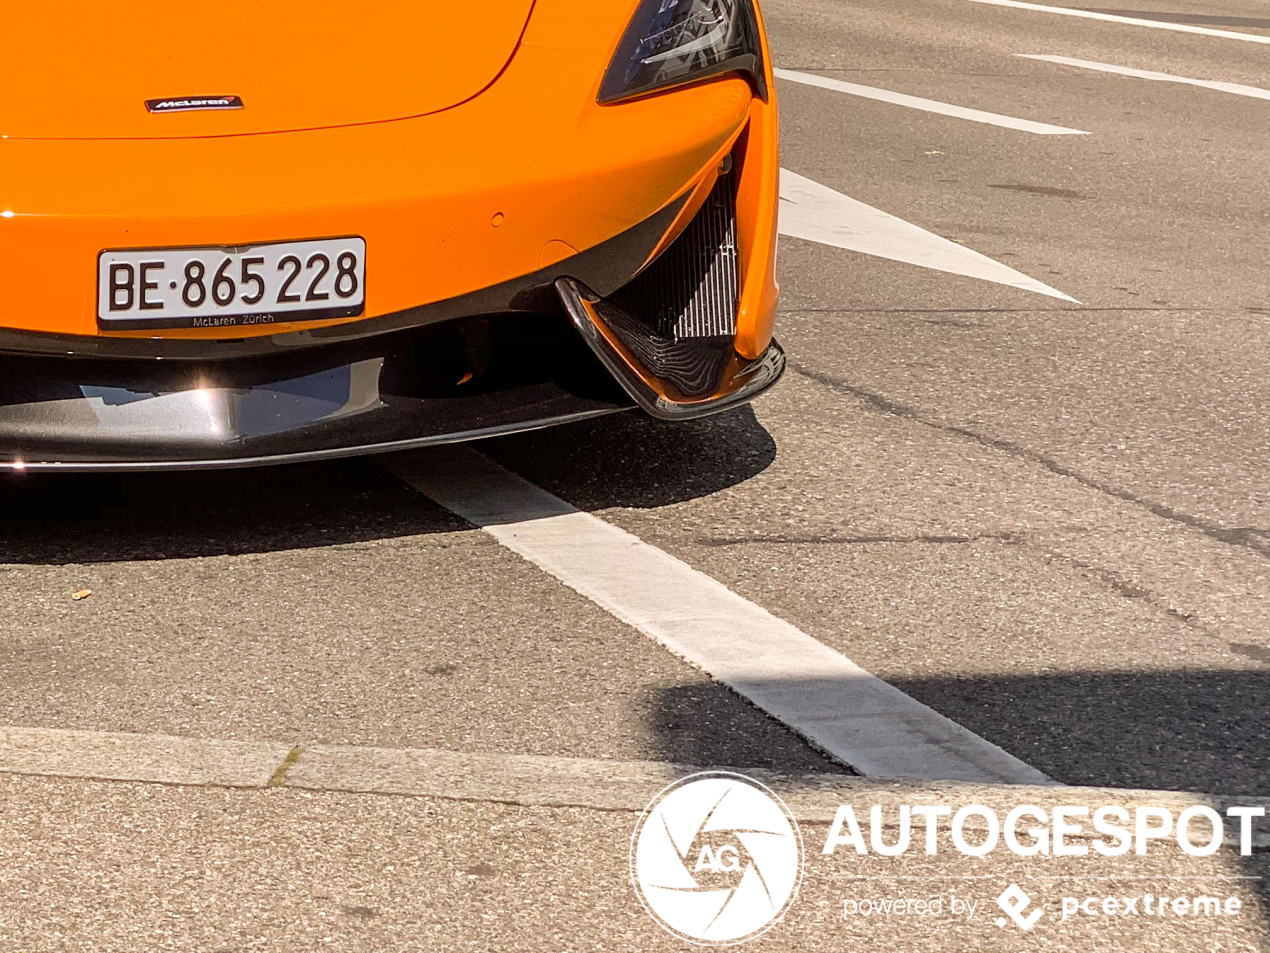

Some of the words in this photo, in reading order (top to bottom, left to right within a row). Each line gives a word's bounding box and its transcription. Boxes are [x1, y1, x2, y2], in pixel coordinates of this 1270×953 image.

[154, 99, 230, 108] McLaren
[192, 316, 236, 327] McLaren
[242, 313, 275, 325] Zürich
